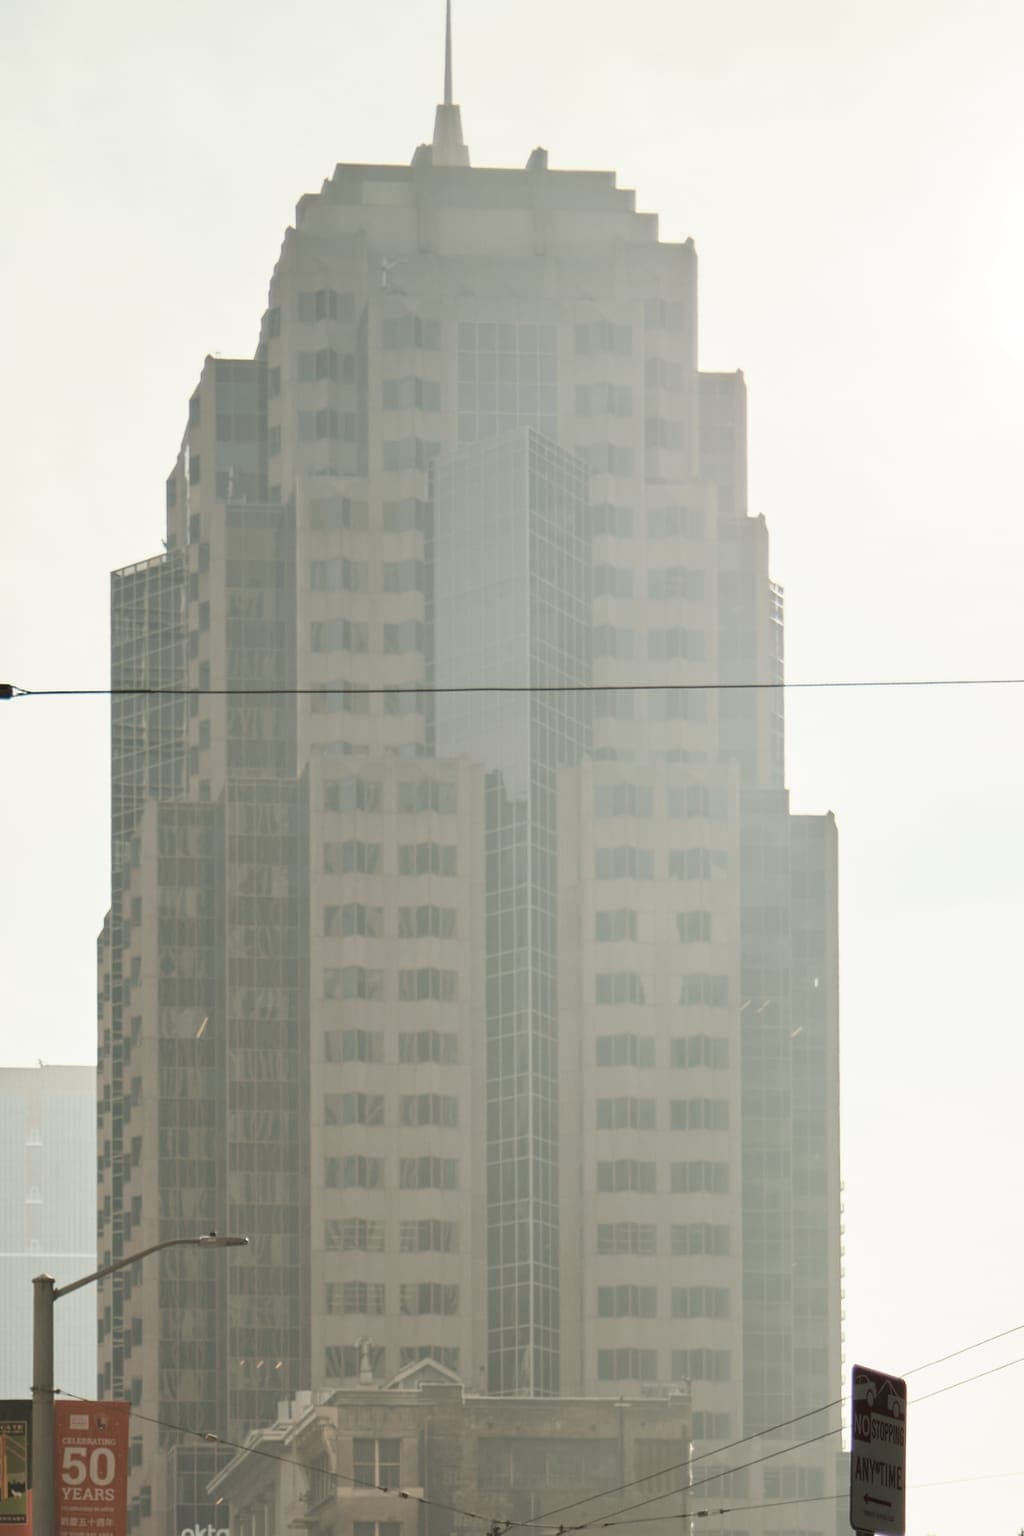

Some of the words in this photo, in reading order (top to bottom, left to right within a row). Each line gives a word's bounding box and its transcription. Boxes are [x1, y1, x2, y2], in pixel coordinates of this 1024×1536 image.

[63, 1437, 116, 1446] CELEBRATING
[856, 1413, 870, 1437] NO
[871, 1418, 904, 1447] STOPPING
[62, 1447, 115, 1486] 50
[62, 1487, 114, 1501] YEARS
